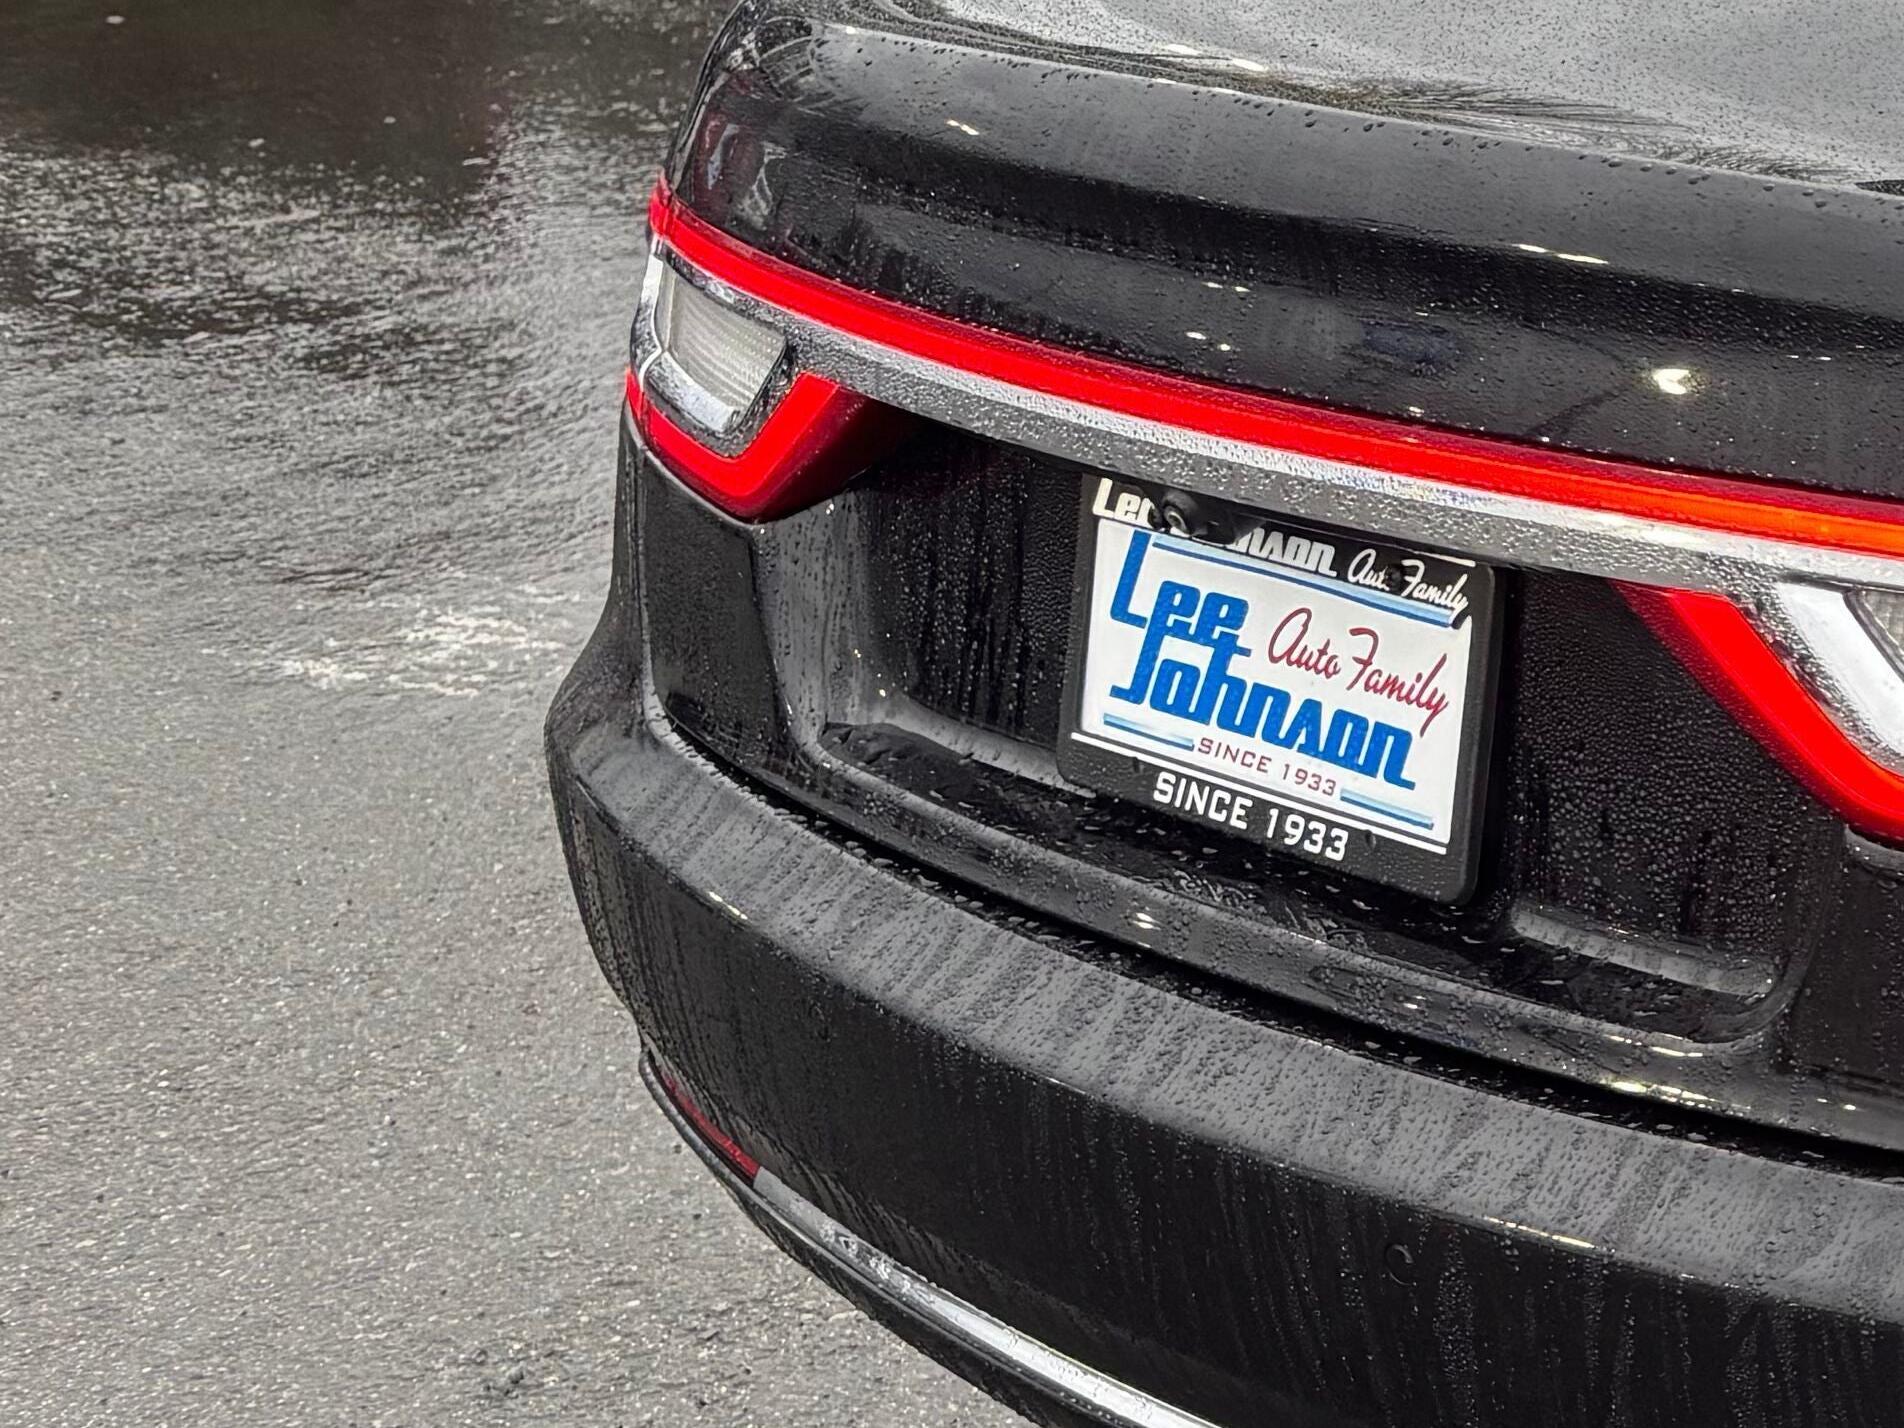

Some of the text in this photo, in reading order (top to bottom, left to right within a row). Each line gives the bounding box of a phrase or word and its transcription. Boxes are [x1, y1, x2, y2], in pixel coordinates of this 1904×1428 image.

[1110, 529, 1249, 642] Lee
[1347, 548, 1391, 591] Aut
[1400, 559, 1469, 629] Family
[1110, 633, 1416, 791] Johnson
[1268, 607, 1449, 738] Auto Family
[1152, 771, 1350, 862] SINCE 1933
[1198, 737, 1337, 797] SINCE 1933
